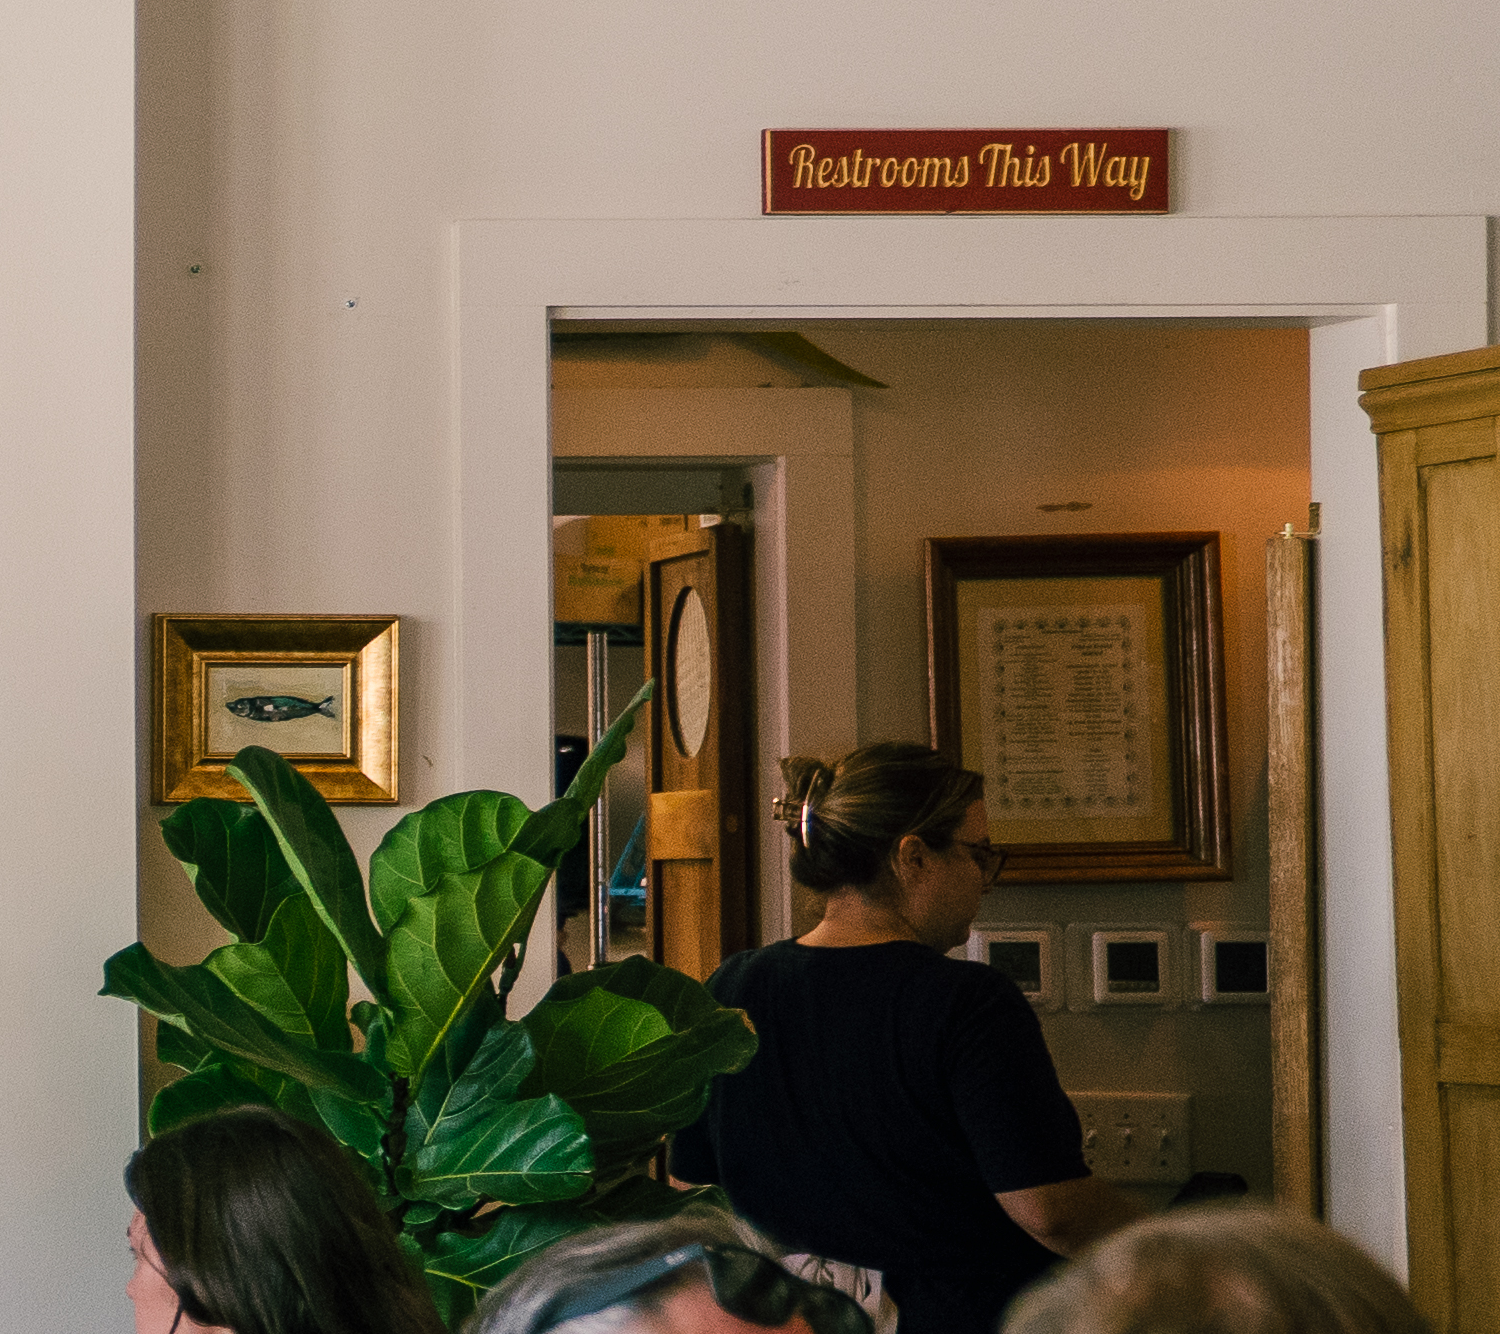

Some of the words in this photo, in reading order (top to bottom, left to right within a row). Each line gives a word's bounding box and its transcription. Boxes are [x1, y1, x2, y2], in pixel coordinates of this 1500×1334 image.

[788, 143, 970, 189] Restrooms
[978, 142, 1051, 188] This
[1059, 141, 1151, 202] Way
